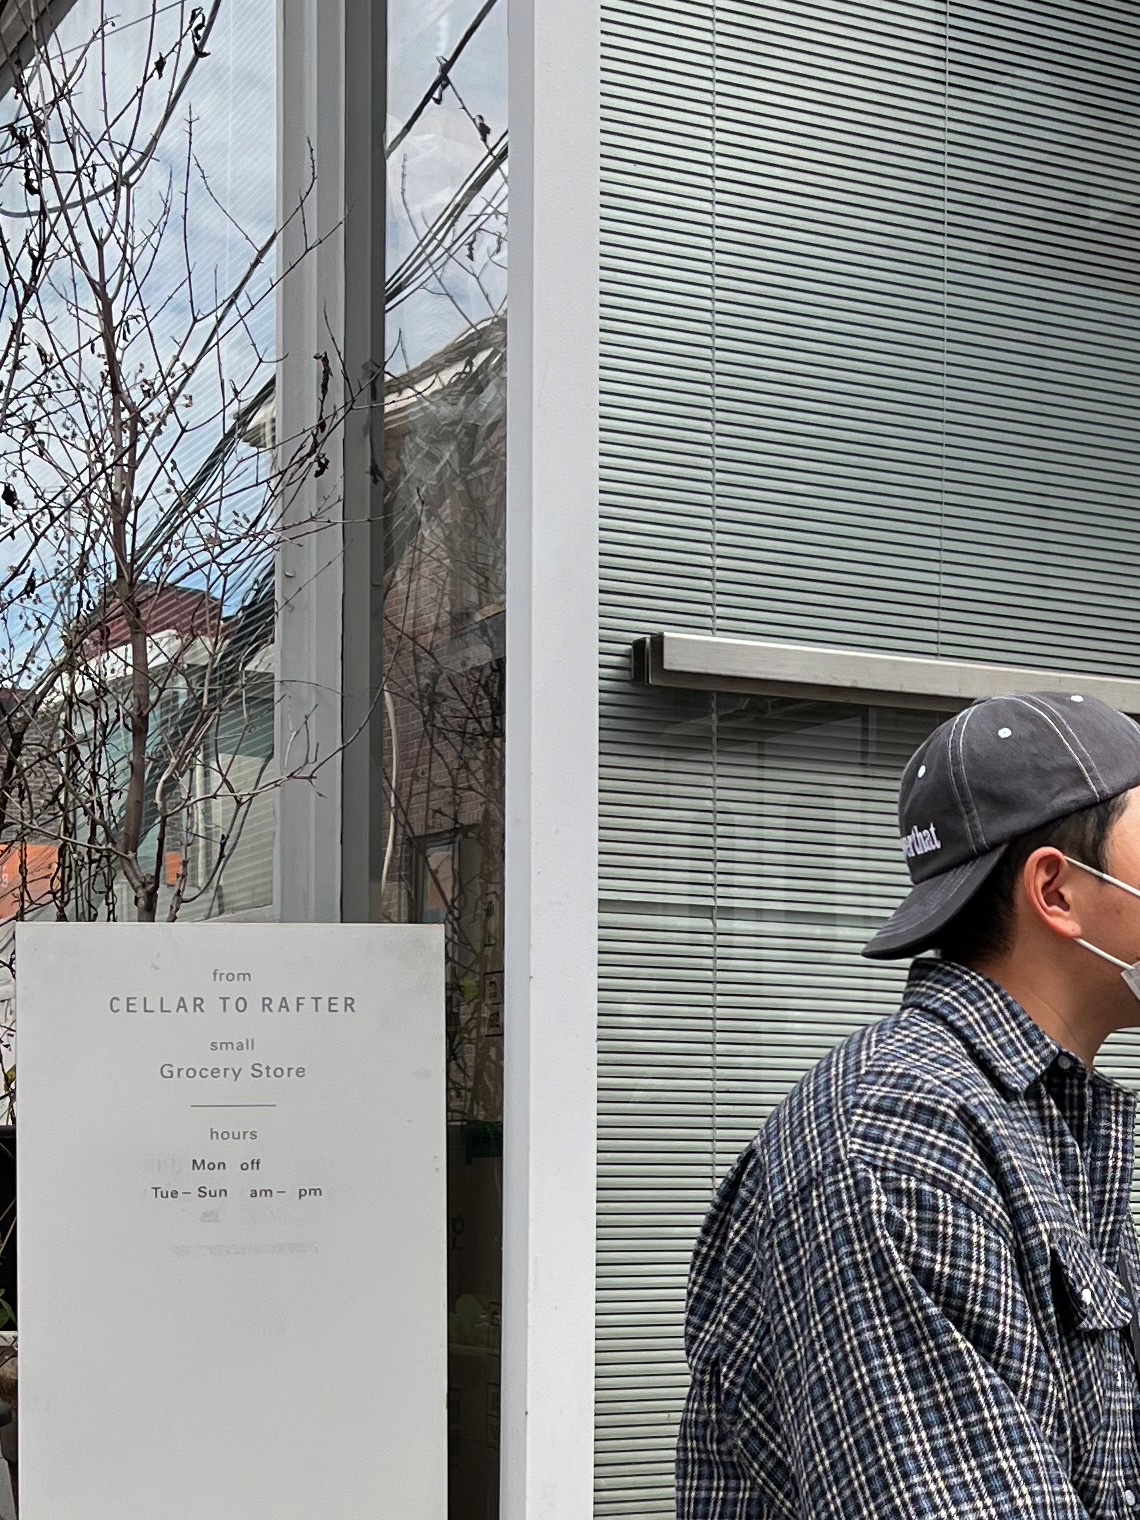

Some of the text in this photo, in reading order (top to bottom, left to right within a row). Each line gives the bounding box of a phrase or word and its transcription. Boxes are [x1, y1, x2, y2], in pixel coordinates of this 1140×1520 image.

[212, 968, 252, 982] from
[109, 996, 356, 1013] CELLAR TO RAFTER
[210, 1037, 255, 1051] small
[160, 1063, 306, 1083] Grocery Store
[209, 1128, 258, 1141] hours
[191, 1158, 261, 1171] Mon off
[298, 1187, 323, 1200] pm
